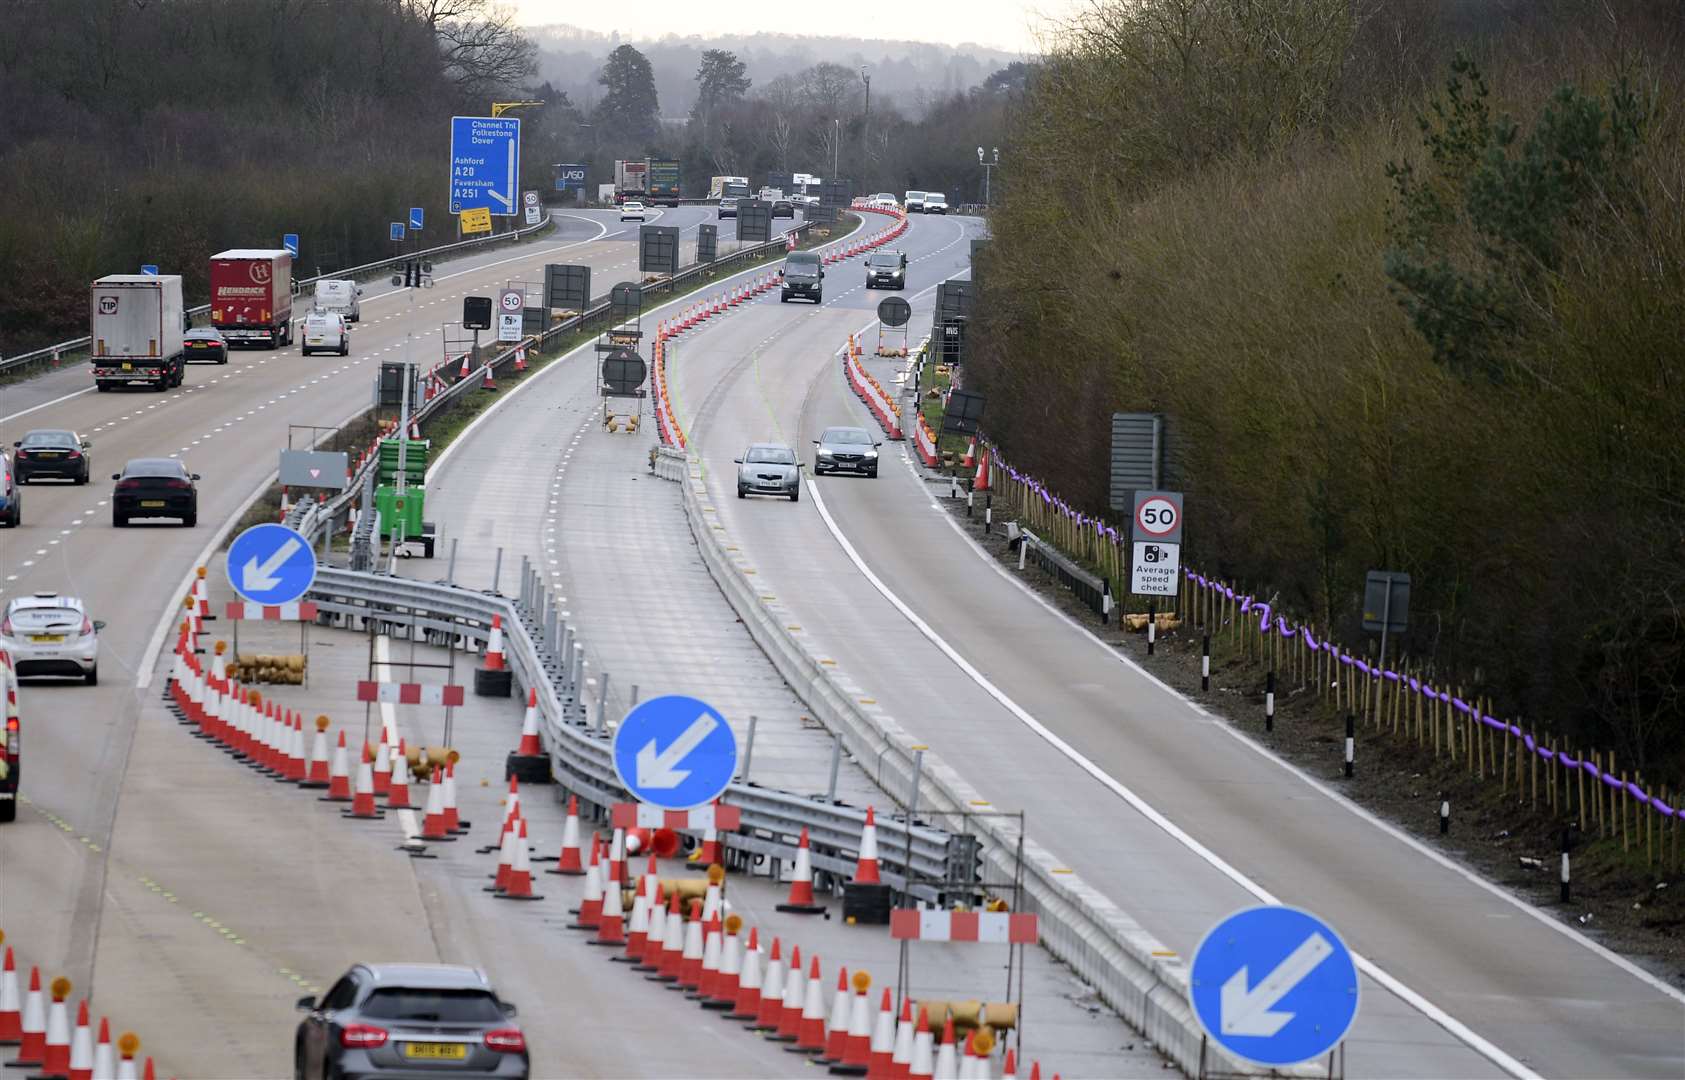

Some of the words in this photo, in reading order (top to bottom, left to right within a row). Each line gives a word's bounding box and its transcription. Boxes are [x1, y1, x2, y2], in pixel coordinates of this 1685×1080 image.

[471, 120, 502, 129] Channel
[505, 121, 516, 129] Tnl
[471, 129, 513, 137] Folkestone
[471, 137, 495, 145] Dover
[454, 157, 485, 165] Ashford
[454, 178, 494, 187] Faversham
[526, 194, 536, 202] 50
[217, 286, 266, 296] HENDRICK
[101, 300, 117, 310] TIP
[504, 297, 520, 306] 50
[1144, 508, 1174, 525] 50
[1136, 565, 1176, 575] Average
[1141, 575, 1169, 583] speed
[1140, 584, 1169, 592] check
